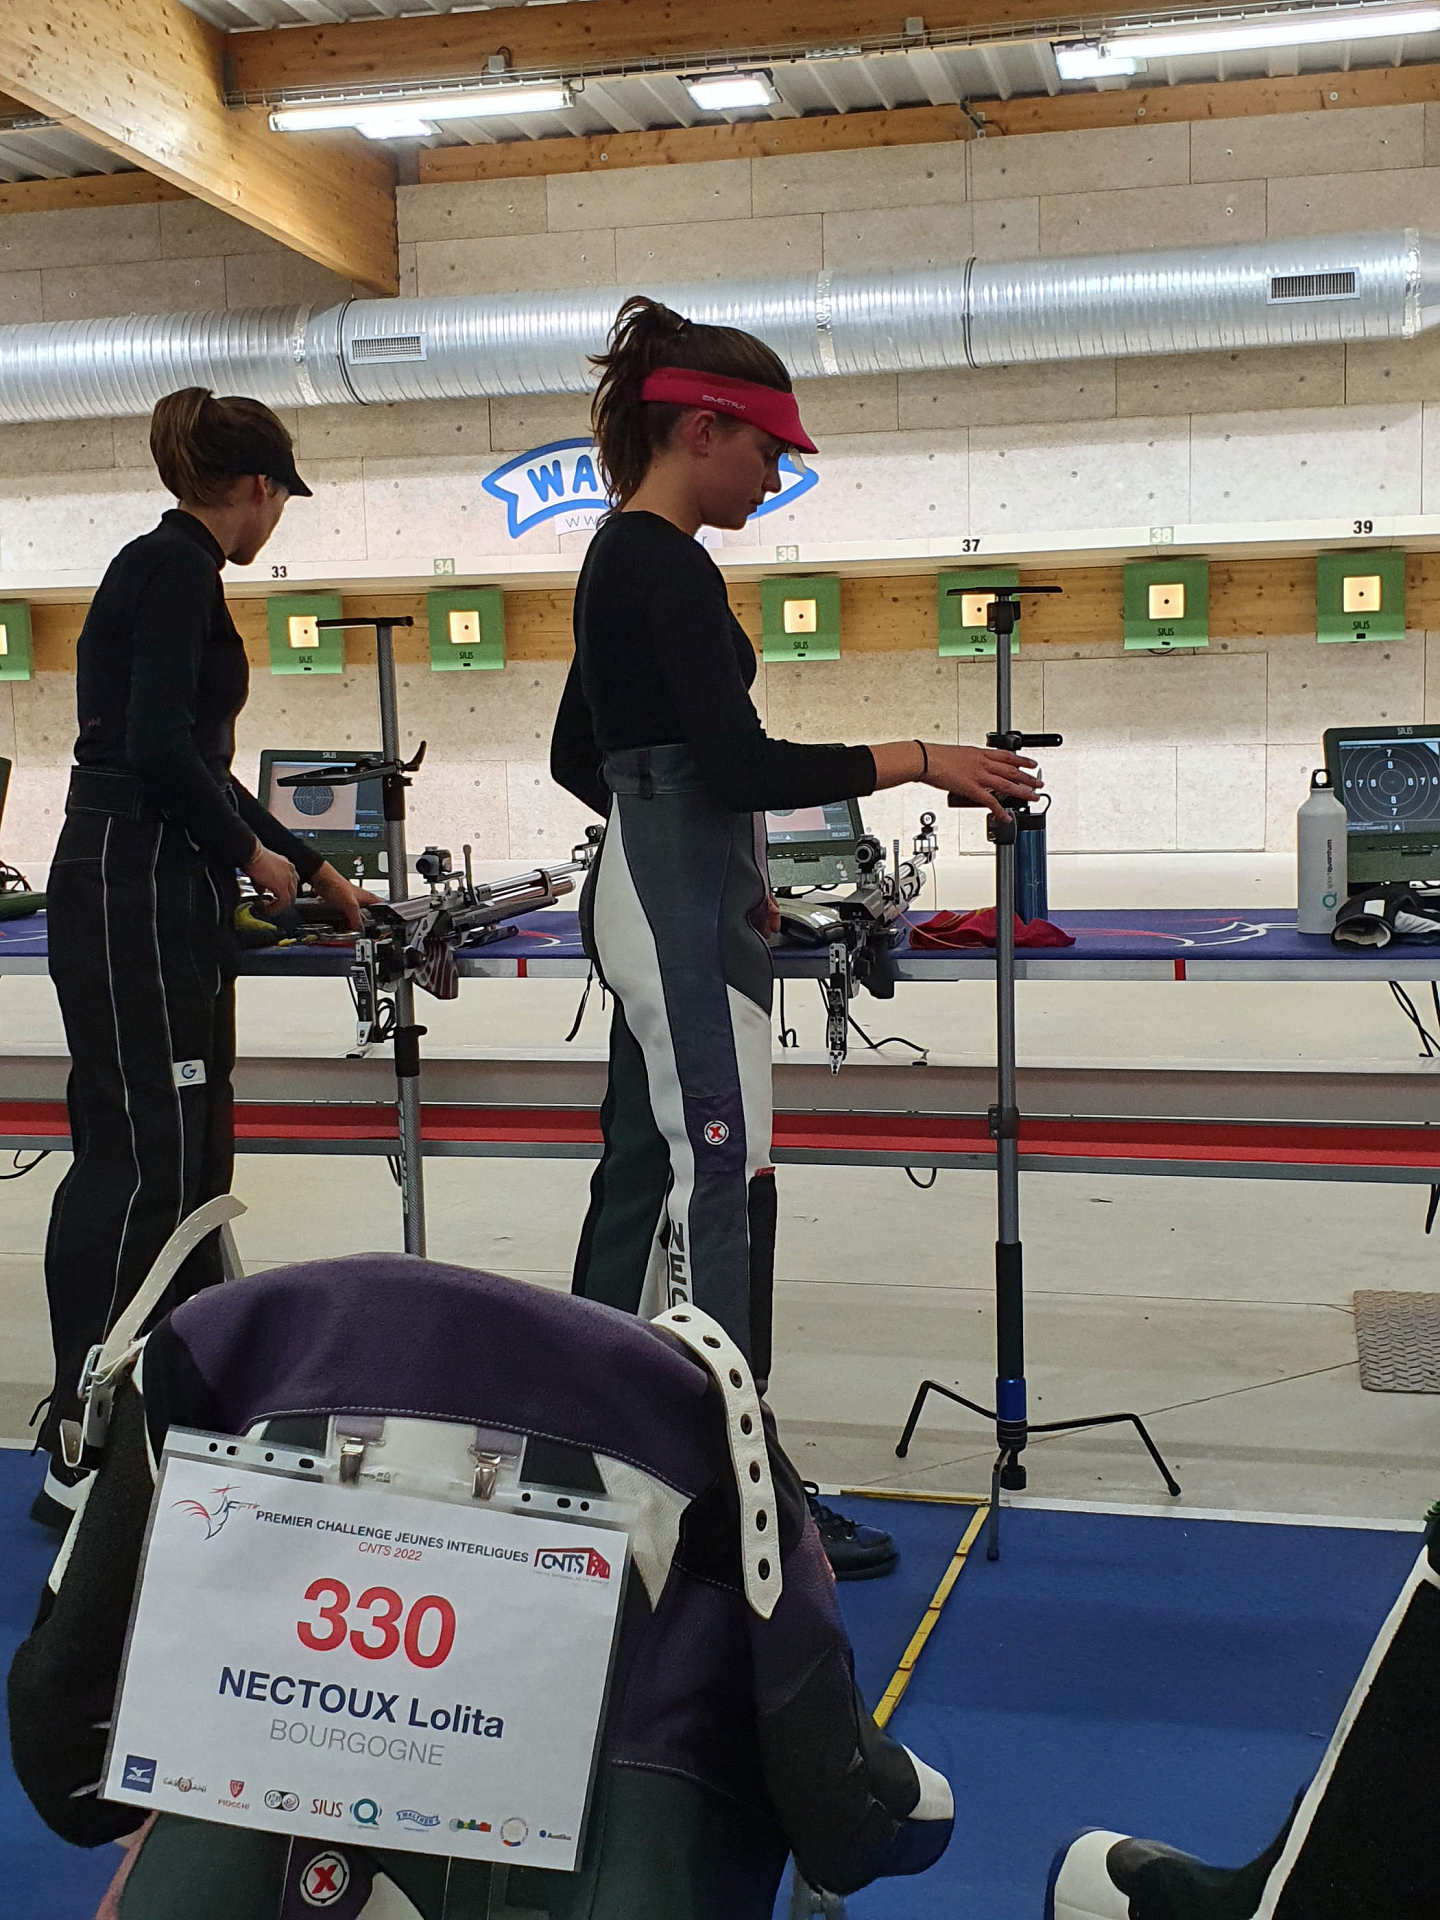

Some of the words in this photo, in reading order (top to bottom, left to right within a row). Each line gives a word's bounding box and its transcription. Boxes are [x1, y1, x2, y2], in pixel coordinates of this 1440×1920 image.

[526, 454, 599, 502] WA
[1353, 520, 1373, 534] 39
[1151, 527, 1173, 543] 38
[962, 538, 981, 553] 37
[777, 546, 798, 561] 36
[271, 565, 288, 578] 33
[434, 559, 453, 574] 34
[1157, 627, 1175, 637] SIUS
[1352, 620, 1371, 631] SIUS
[793, 640, 809, 650] SIUS
[970, 634, 987, 644] SIUS
[1386, 749, 1392, 757] 7
[1387, 761, 1393, 769] 8
[1346, 780, 1352, 788] 6
[1358, 779, 1364, 787] 7
[1420, 777, 1426, 785] 7
[1391, 795, 1396, 804] 8
[1391, 807, 1397, 816] 7
[181, 1064, 197, 1079] G
[256, 1510, 313, 1529] PREMIER
[316, 1519, 392, 1541] CHALLENGE
[394, 1532, 444, 1549] JEUNES
[446, 1540, 529, 1563] INTERLIGUES
[358, 1541, 391, 1557] CNTS
[393, 1548, 423, 1562] 2022
[541, 1553, 585, 1574] CNTS
[297, 1577, 456, 1669] 330
[218, 1666, 400, 1723] NECTOUX
[408, 1697, 504, 1738] Lolita
[269, 1719, 445, 1766] BOURGOGNE
[217, 1799, 250, 1811] FIOCCHI
[310, 1798, 343, 1818] SIUS
